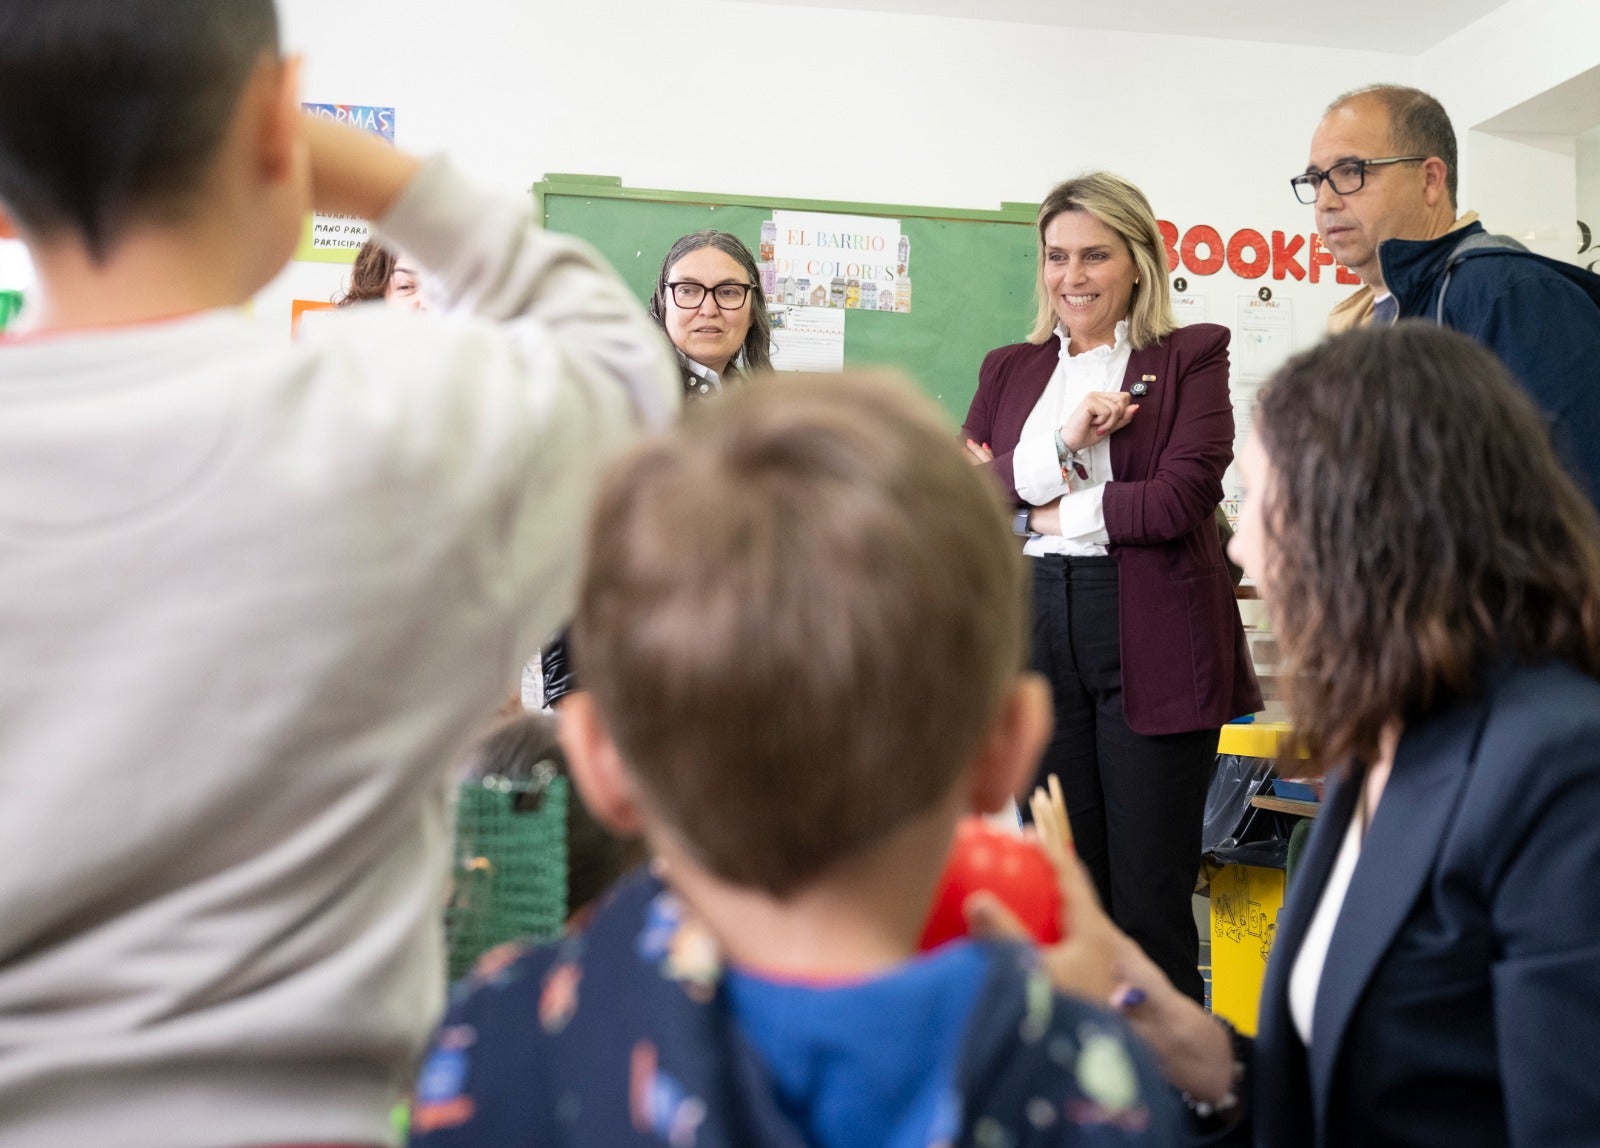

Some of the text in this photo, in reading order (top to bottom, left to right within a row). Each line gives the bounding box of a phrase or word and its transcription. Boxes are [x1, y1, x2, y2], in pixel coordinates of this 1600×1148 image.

[315, 224, 368, 235] MANO PARA
[314, 238, 363, 248] PARTICIPA
[788, 229, 885, 252] EL BARRIO
[777, 258, 894, 281] DE COLORES
[1261, 289, 1268, 299] 2
